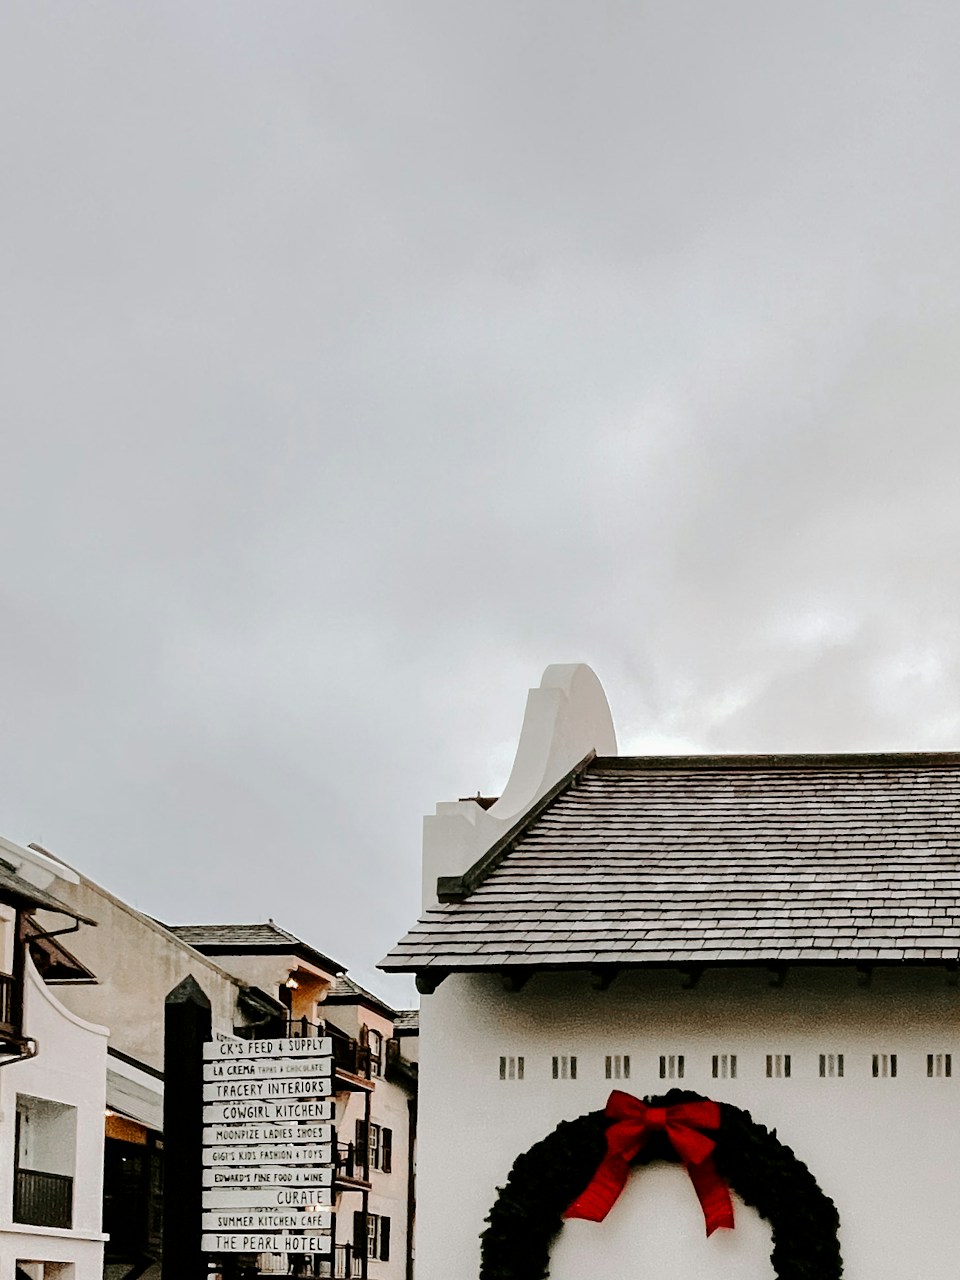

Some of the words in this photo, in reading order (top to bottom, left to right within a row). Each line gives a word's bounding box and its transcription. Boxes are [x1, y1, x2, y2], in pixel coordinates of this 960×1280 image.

[248, 1042, 273, 1053] FEED
[289, 1039, 323, 1051] SUPPLY
[213, 1066, 223, 1076] LA
[226, 1065, 255, 1075] CREMA
[285, 1063, 323, 1072] CHOCOLATE
[216, 1084, 263, 1097] TRACERY
[268, 1081, 324, 1095] INTERIORS
[222, 1106, 270, 1119] COWGIRL
[275, 1104, 323, 1117] KITCHEN
[263, 1129, 294, 1138] LADIES
[297, 1127, 323, 1138] SHOES
[239, 1151, 257, 1160] KIDS
[260, 1150, 292, 1159] FASHION
[303, 1149, 323, 1158] TOYS
[253, 1173, 271, 1182] FINE
[274, 1173, 293, 1182] FOOD
[303, 1173, 323, 1182] WINE
[277, 1190, 323, 1205] CURATE
[218, 1216, 254, 1227] SUMMER
[258, 1216, 297, 1226] KITCHEN
[301, 1214, 323, 1226] CAFÉ
[216, 1235, 237, 1249] THE
[243, 1236, 279, 1249] PEARL
[285, 1237, 323, 1251] HOTEL
